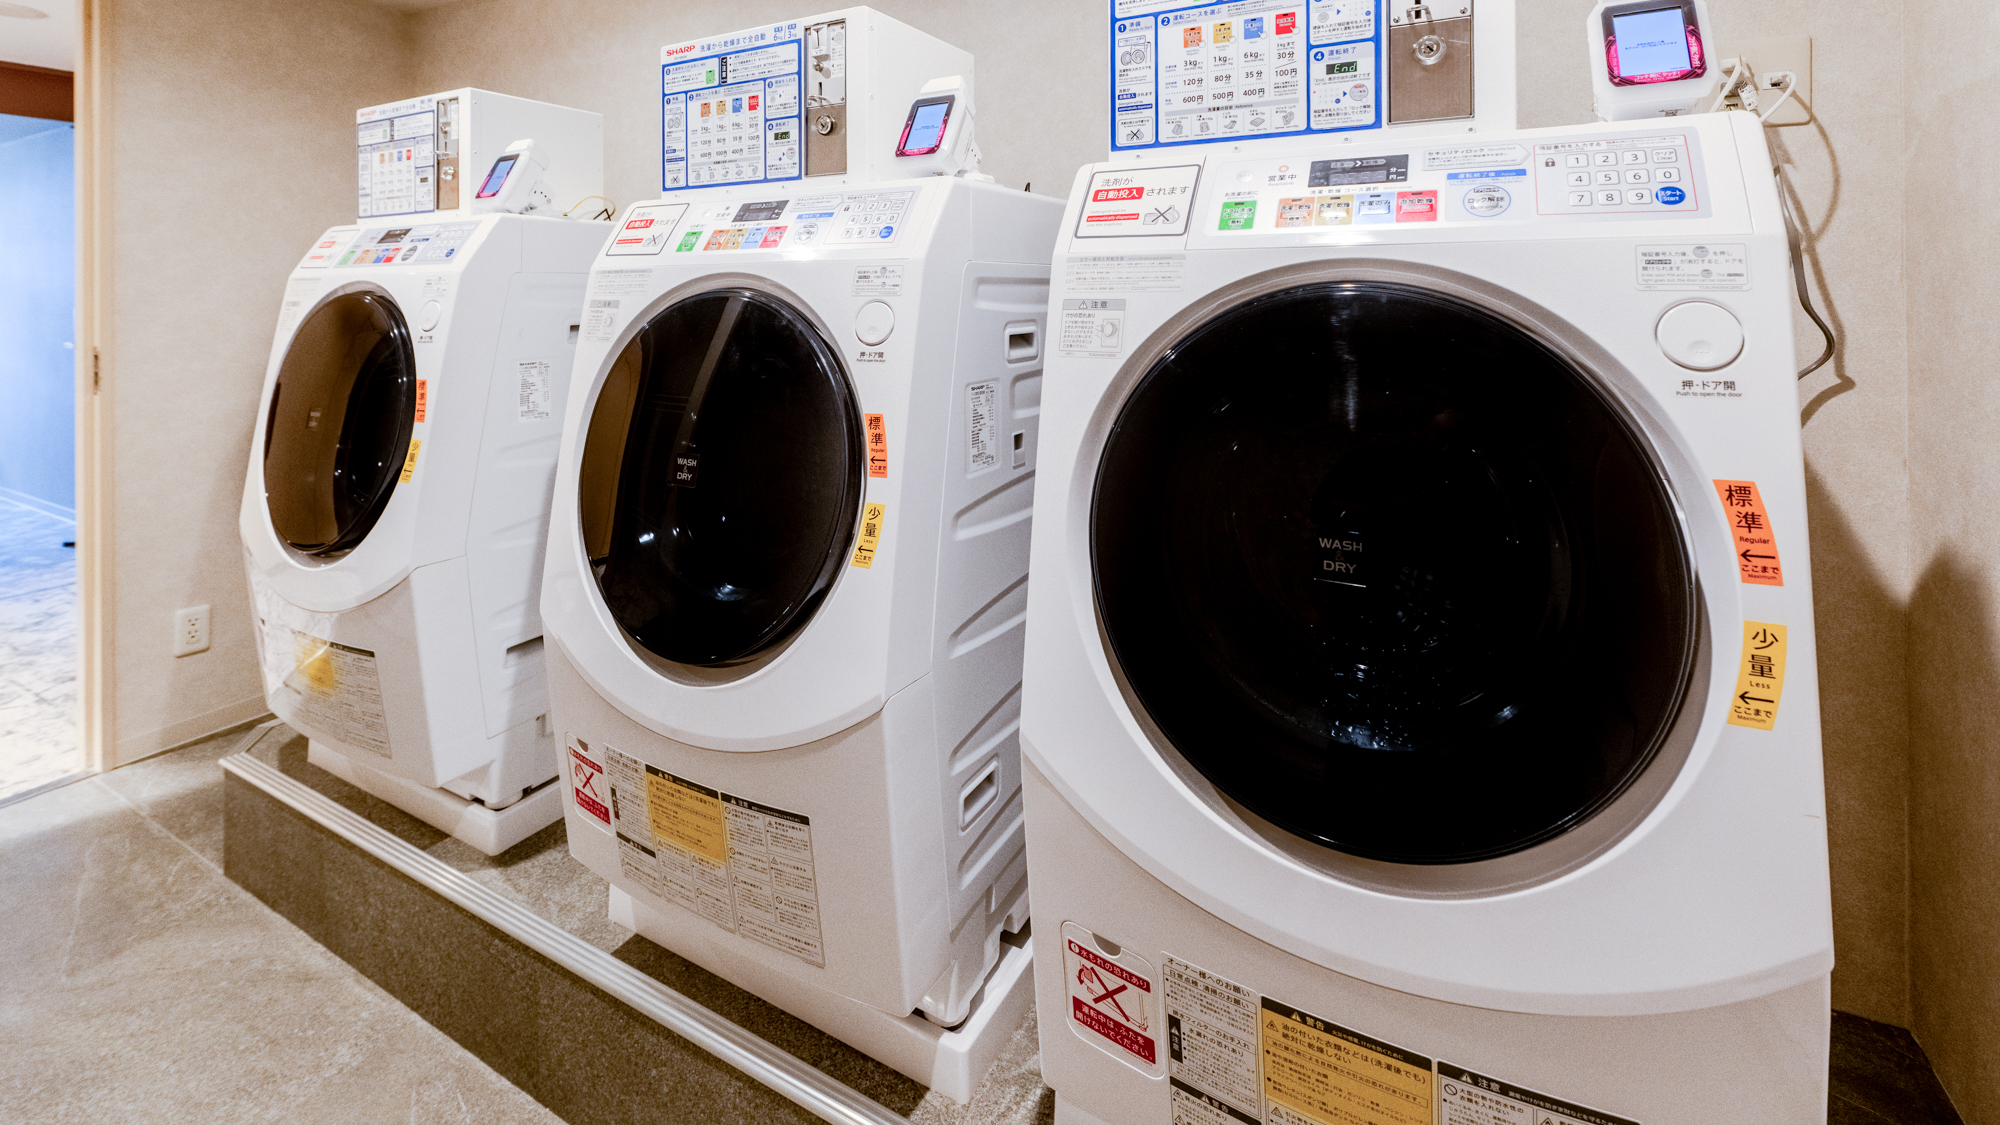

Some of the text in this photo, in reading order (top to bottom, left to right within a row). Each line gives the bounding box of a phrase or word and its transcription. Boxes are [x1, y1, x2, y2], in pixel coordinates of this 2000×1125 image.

[1173, 7, 1222, 21] 運転コースを選ぶ
[700, 33, 766, 53] 洗濯から乾燥まで全自動
[666, 44, 696, 57] SHARP
[1328, 46, 1357, 57] 運転終了
[1334, 63, 1357, 75] End
[1212, 91, 1234, 100] 500円
[1243, 88, 1265, 97] 400円
[1182, 95, 1204, 103] 600円
[1428, 148, 1485, 156] セキュリティロック
[1602, 155, 1610, 163] 2
[1268, 174, 1297, 182] 営業中
[1575, 175, 1583, 183] 4
[1633, 172, 1641, 180] 6
[1663, 171, 1672, 179] 0
[1101, 177, 1134, 187] 洗剤が
[1097, 186, 1190, 200] 自動投入 されます
[1605, 193, 1614, 201] 8
[1635, 192, 1644, 200] 9
[1468, 196, 1505, 204] ロック解除
[1090, 301, 1109, 309] 注意
[868, 416, 884, 447] 標準
[677, 457, 698, 467] WASH
[676, 472, 693, 481] DRY
[1725, 484, 1763, 533] 標準
[864, 507, 881, 538] 少量
[1319, 537, 1363, 552] WASH
[1739, 535, 1770, 545] Regular
[854, 554, 872, 562] ここまで
[1323, 560, 1357, 574] DRY
[1741, 564, 1779, 575] ここまで
[1748, 573, 1778, 581] Maximum
[1748, 628, 1779, 679] 少量
[1749, 680, 1771, 690] Less
[1734, 705, 1773, 719] ここまで
[1737, 714, 1767, 724] Maximum
[1081, 949, 1147, 989] 水もれの恐れあり
[1168, 957, 1250, 997] オーナー様へのお願い
[1081, 1004, 1145, 1046] 運転中は、ふたを
[1306, 1016, 1325, 1031] 警告
[1075, 1010, 1153, 1061] 開けないでください。
[1282, 1031, 1352, 1064] 絶対に乾燥しない
[1478, 1077, 1501, 1093] 注意
